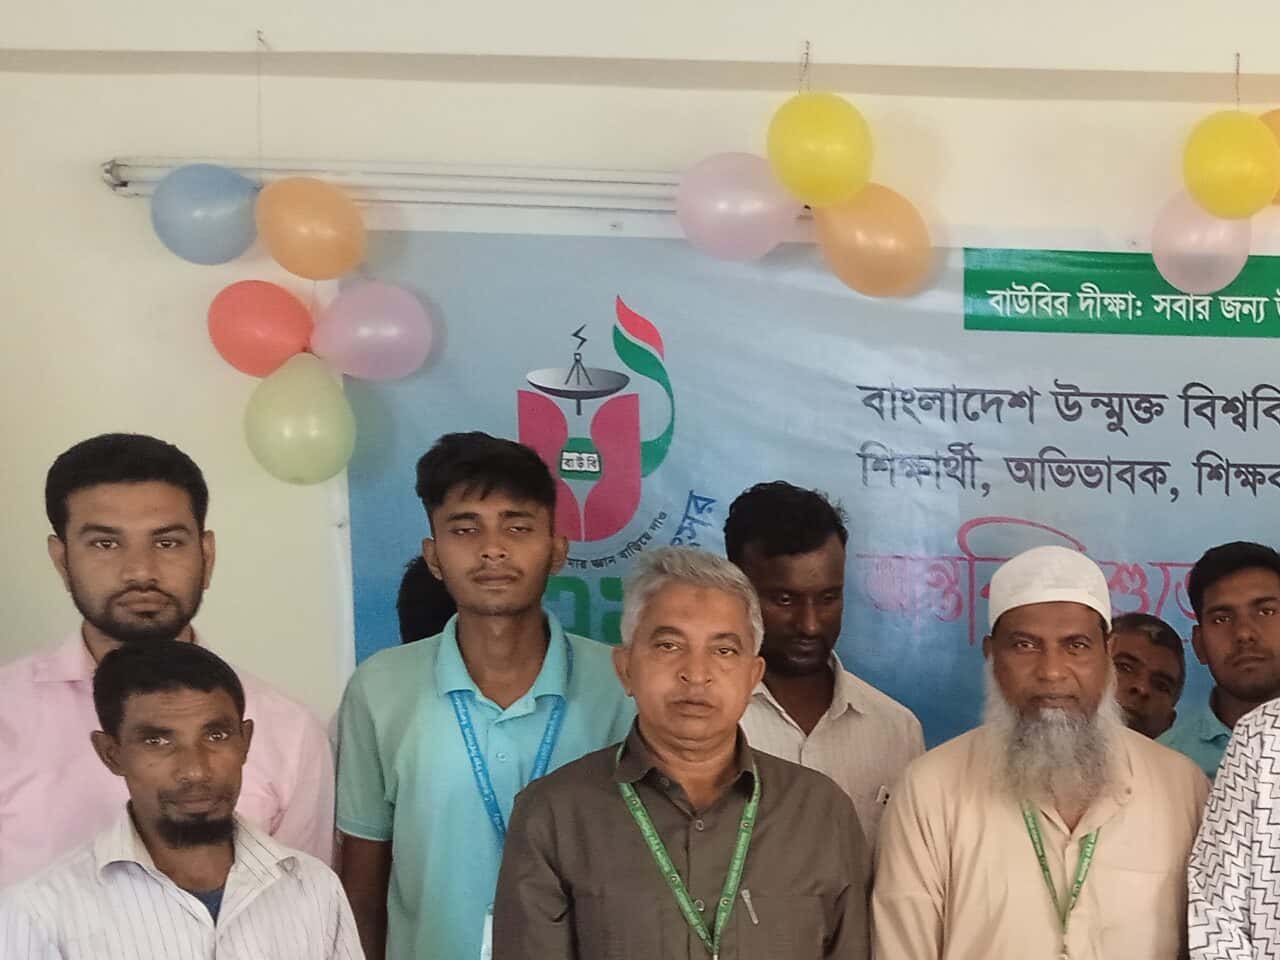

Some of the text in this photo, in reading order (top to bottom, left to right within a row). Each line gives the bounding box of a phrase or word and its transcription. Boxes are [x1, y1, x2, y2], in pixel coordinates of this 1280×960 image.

[985, 281, 1071, 318] বাউবির
[1077, 283, 1143, 321] দীক্ষা:
[1152, 293, 1216, 323] সবার
[1218, 296, 1269, 324] জন্য
[856, 377, 1042, 425] বাংলাদেশ
[1049, 378, 1169, 436] উন্মুক্ত
[856, 440, 991, 498] শিক্ষার্থী,
[1003, 445, 1180, 503] অভিভাবক,
